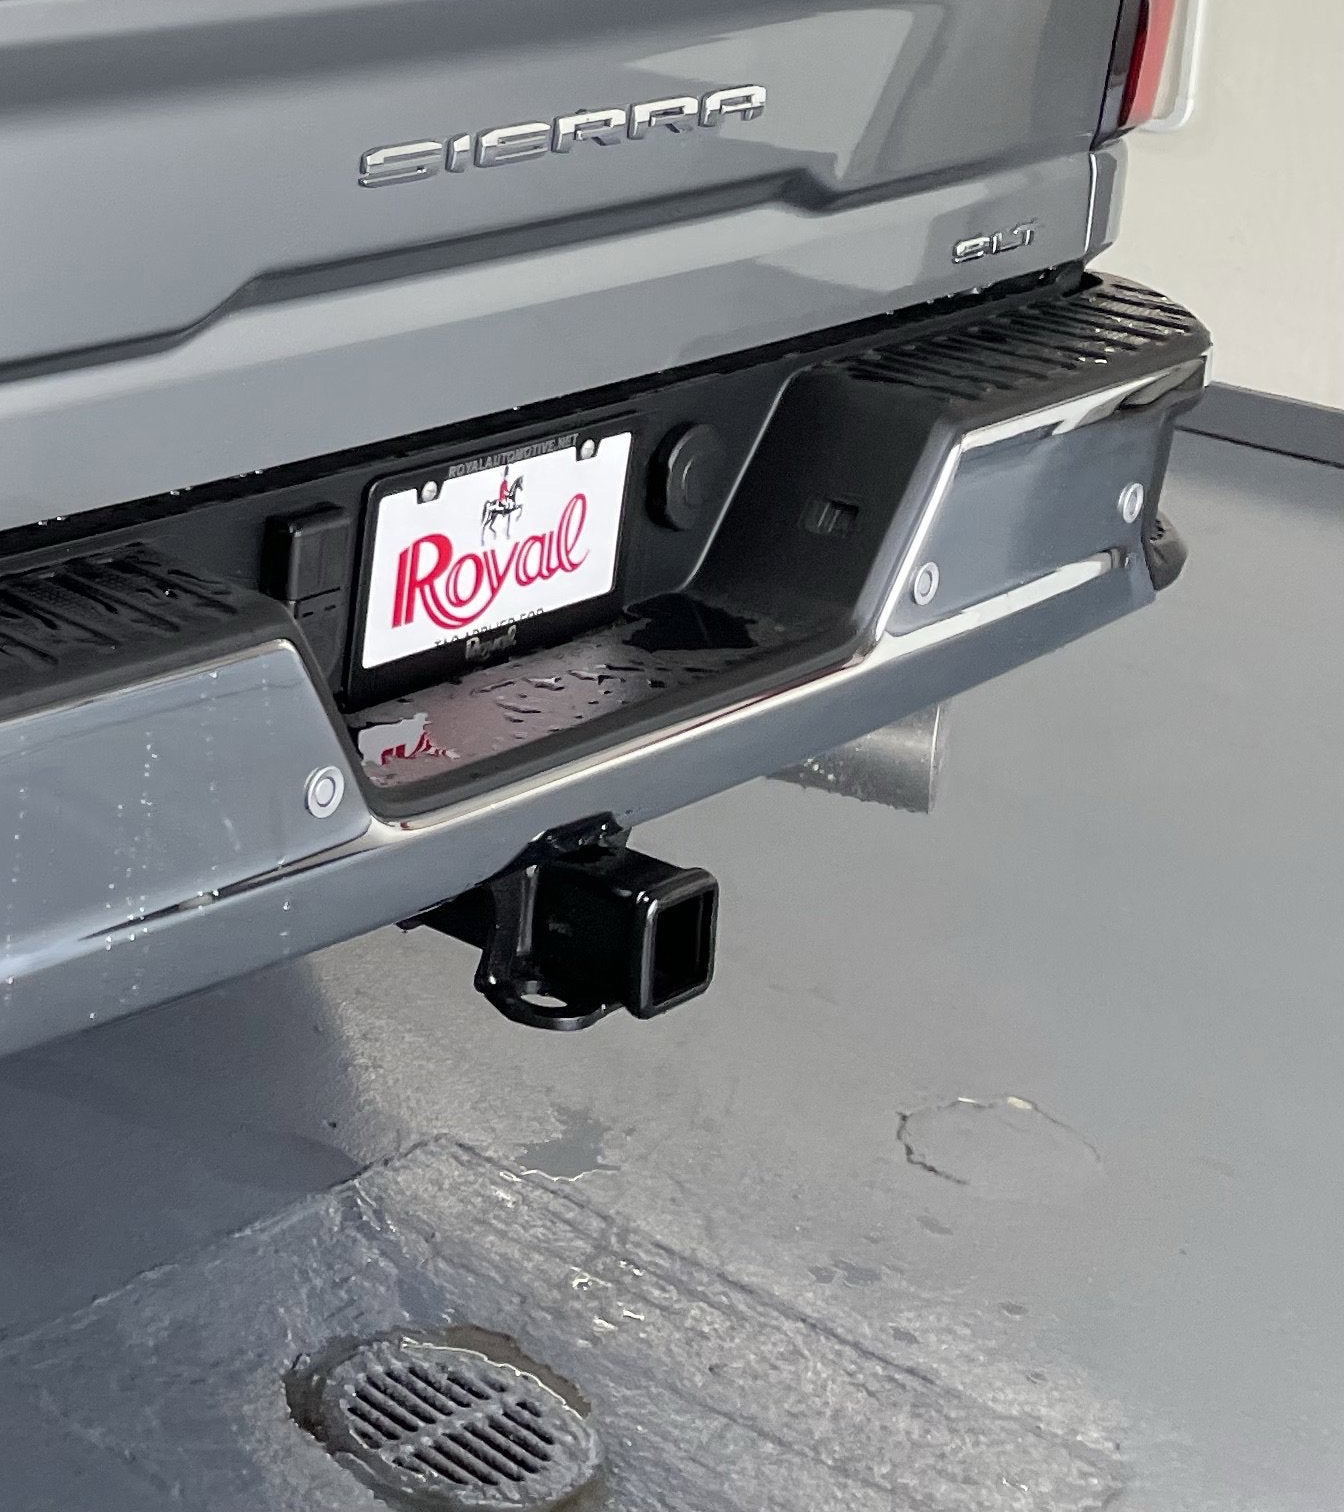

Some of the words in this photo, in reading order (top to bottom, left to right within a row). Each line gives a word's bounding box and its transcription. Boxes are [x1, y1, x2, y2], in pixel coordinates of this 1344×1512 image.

[357, 84, 767, 188] SIERRA
[951, 219, 1036, 264] SLT
[391, 492, 590, 630] Royal
